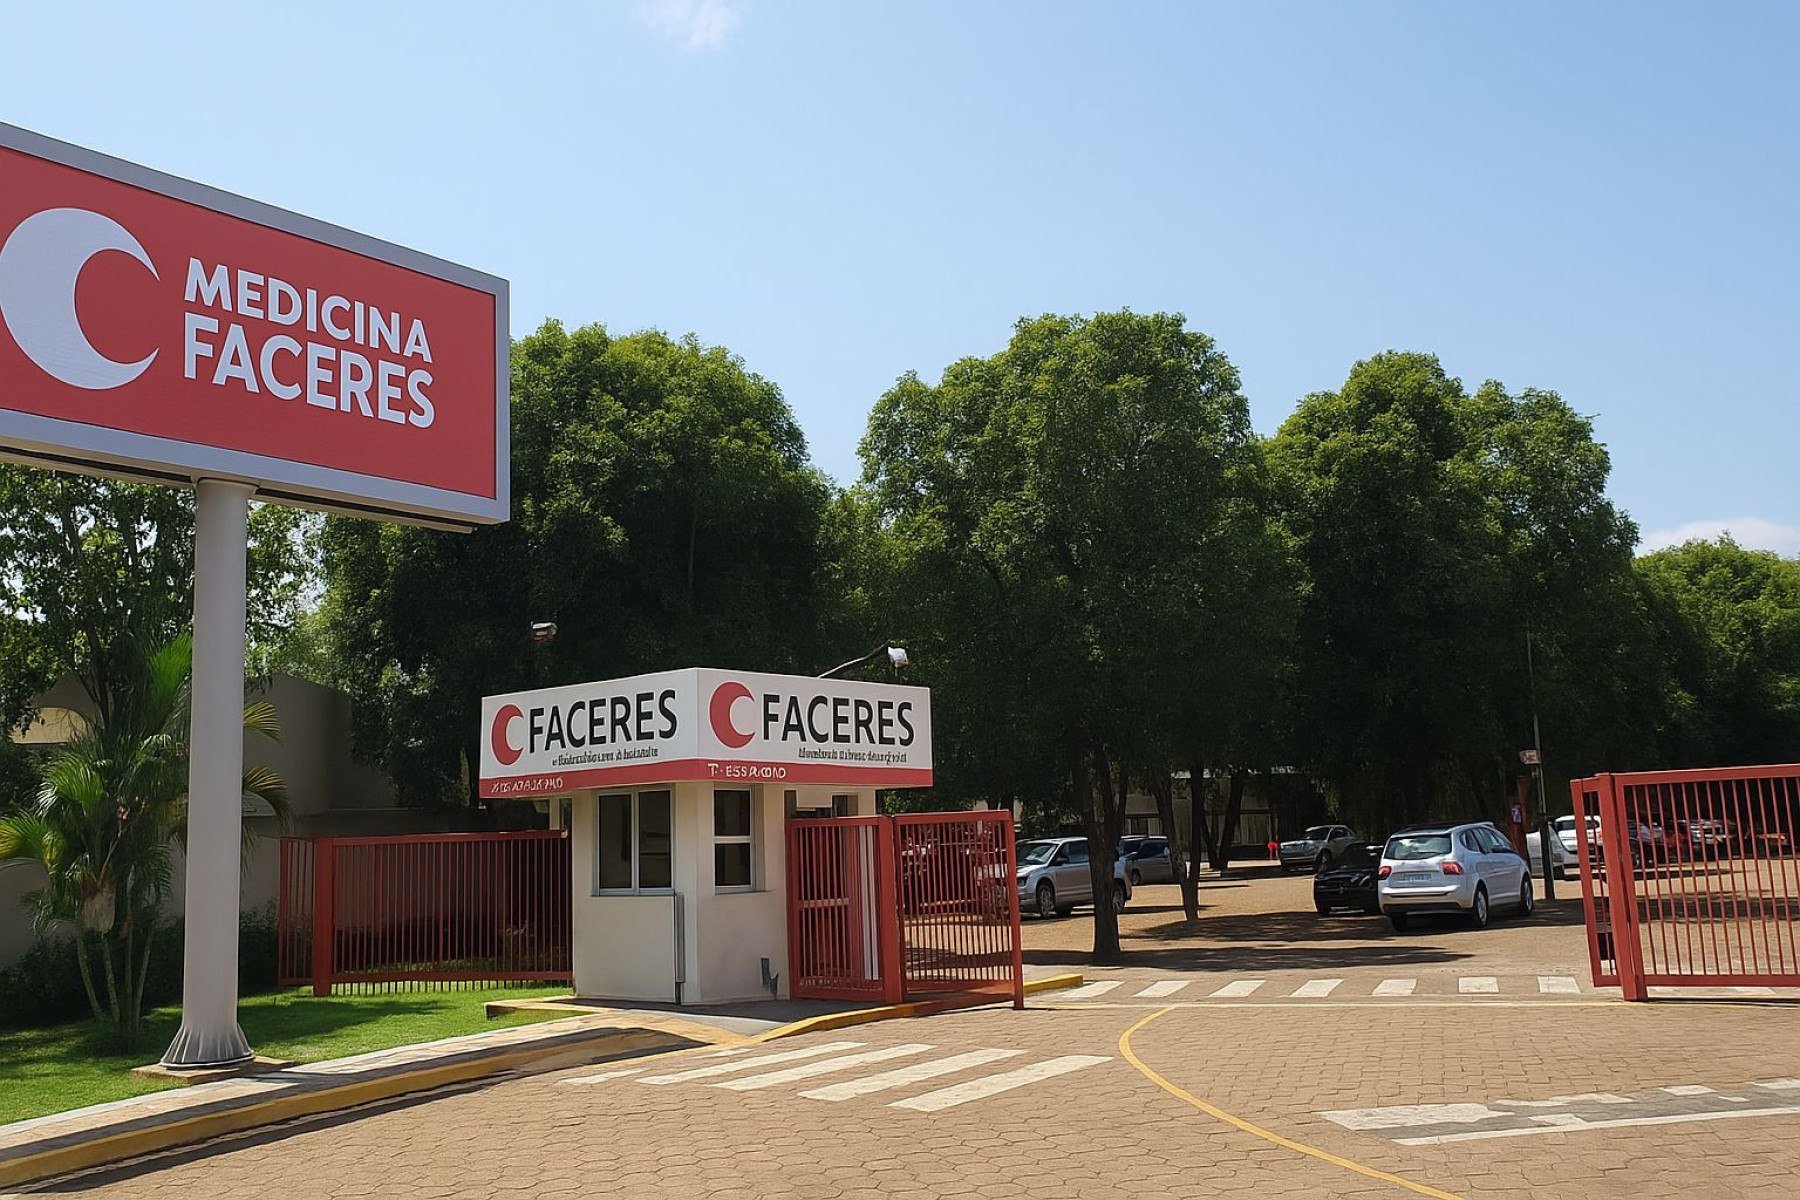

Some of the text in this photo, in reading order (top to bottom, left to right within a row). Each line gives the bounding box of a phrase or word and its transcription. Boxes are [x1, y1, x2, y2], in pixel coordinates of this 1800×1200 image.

[184, 257, 433, 363] MEDICINA
[183, 312, 436, 428] FACERES
[529, 689, 678, 754] FACERES
[763, 694, 915, 746] FACERES
